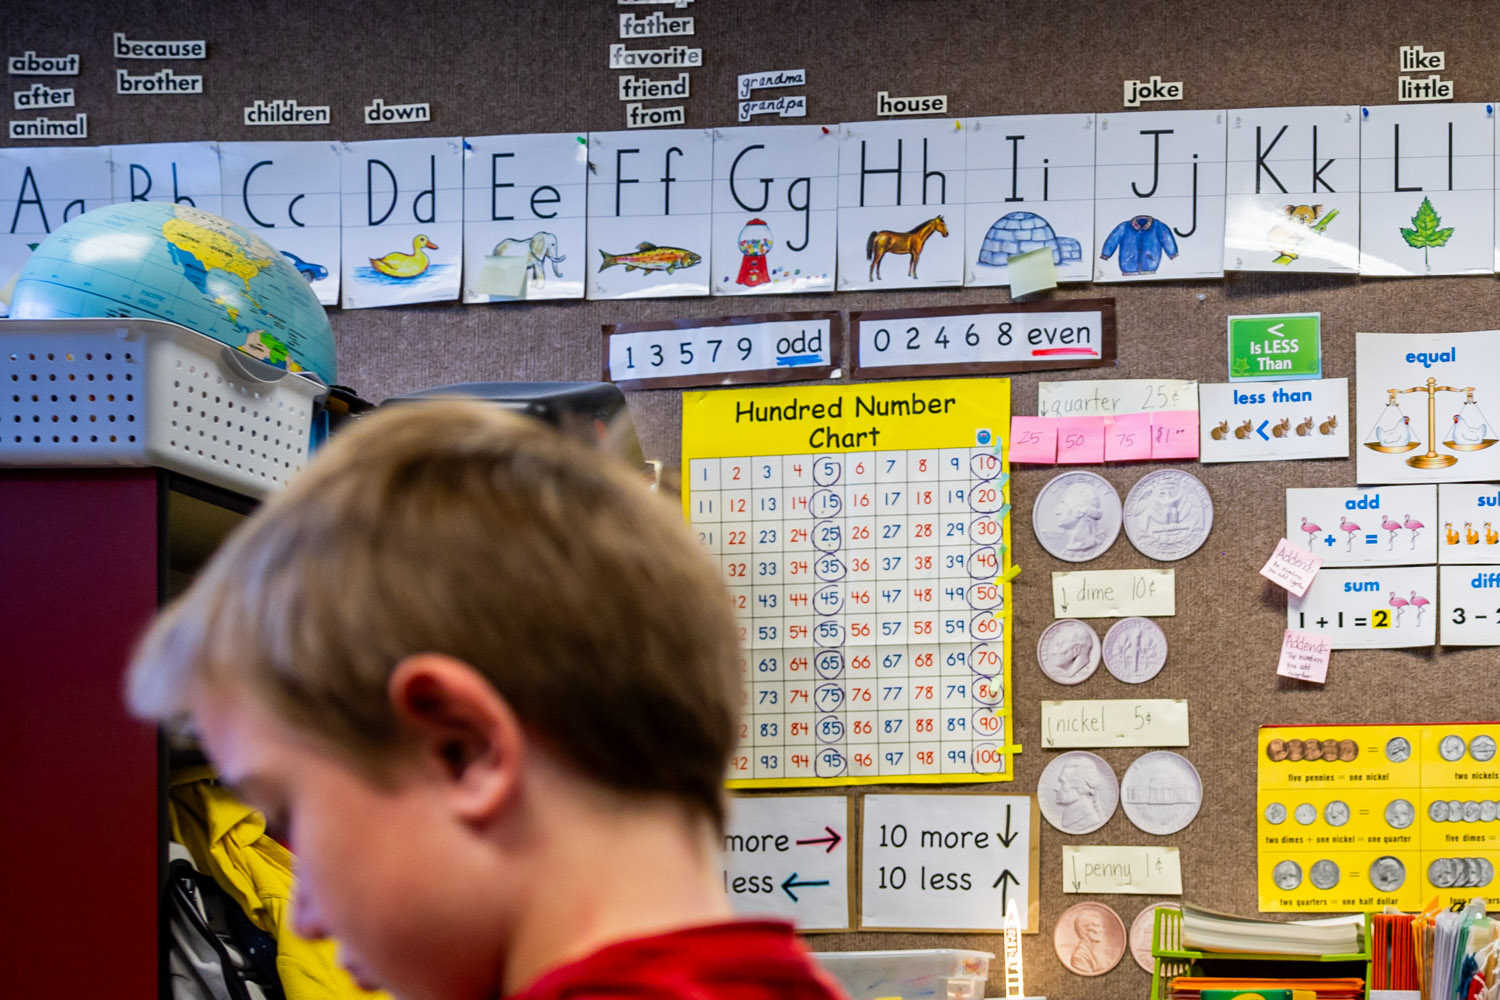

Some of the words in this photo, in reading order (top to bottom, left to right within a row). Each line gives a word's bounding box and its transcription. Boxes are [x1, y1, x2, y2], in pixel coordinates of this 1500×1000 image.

[623, 16, 692, 34] father
[116, 38, 203, 58] because
[613, 46, 699, 67] favorite
[12, 55, 78, 73] about
[1403, 50, 1441, 69] like
[119, 73, 200, 92] brother
[622, 77, 687, 97] friend
[742, 73, 803, 94] grandma
[1130, 79, 1180, 101] joke
[1402, 79, 1451, 97] little
[17, 88, 72, 104] after
[879, 94, 944, 112] house
[247, 102, 328, 122] children
[368, 102, 428, 121] down
[630, 105, 683, 124] from
[742, 98, 804, 118] grandpa
[13, 117, 86, 137] animal
[873, 328, 891, 353] 0
[905, 326, 922, 351] 2
[934, 326, 951, 349] 4
[964, 324, 981, 348] 6
[997, 322, 1014, 347] 8
[1027, 324, 1092, 346] even
[1251, 341, 1261, 354] Is
[1264, 339, 1299, 354] LESS
[624, 346, 635, 370] 1
[649, 343, 665, 368] 3
[679, 341, 694, 365] 5
[706, 339, 723, 364] 7
[736, 337, 753, 362] 9
[775, 330, 823, 356] odd
[1405, 348, 1456, 369] equal
[1257, 357, 1292, 371] Than
[1233, 389, 1269, 406] less
[1272, 388, 1312, 405] than
[735, 398, 843, 424] Hundred
[855, 394, 956, 417] Number
[808, 426, 881, 449] Chart
[1345, 494, 1380, 511] add
[1076, 583, 1115, 601] dime
[1344, 579, 1380, 593] sum
[1057, 709, 1106, 733] nickel
[879, 824, 907, 848] 10
[921, 828, 989, 848] more
[878, 867, 906, 890] 10
[921, 867, 972, 891] less
[1083, 860, 1131, 884] penny
